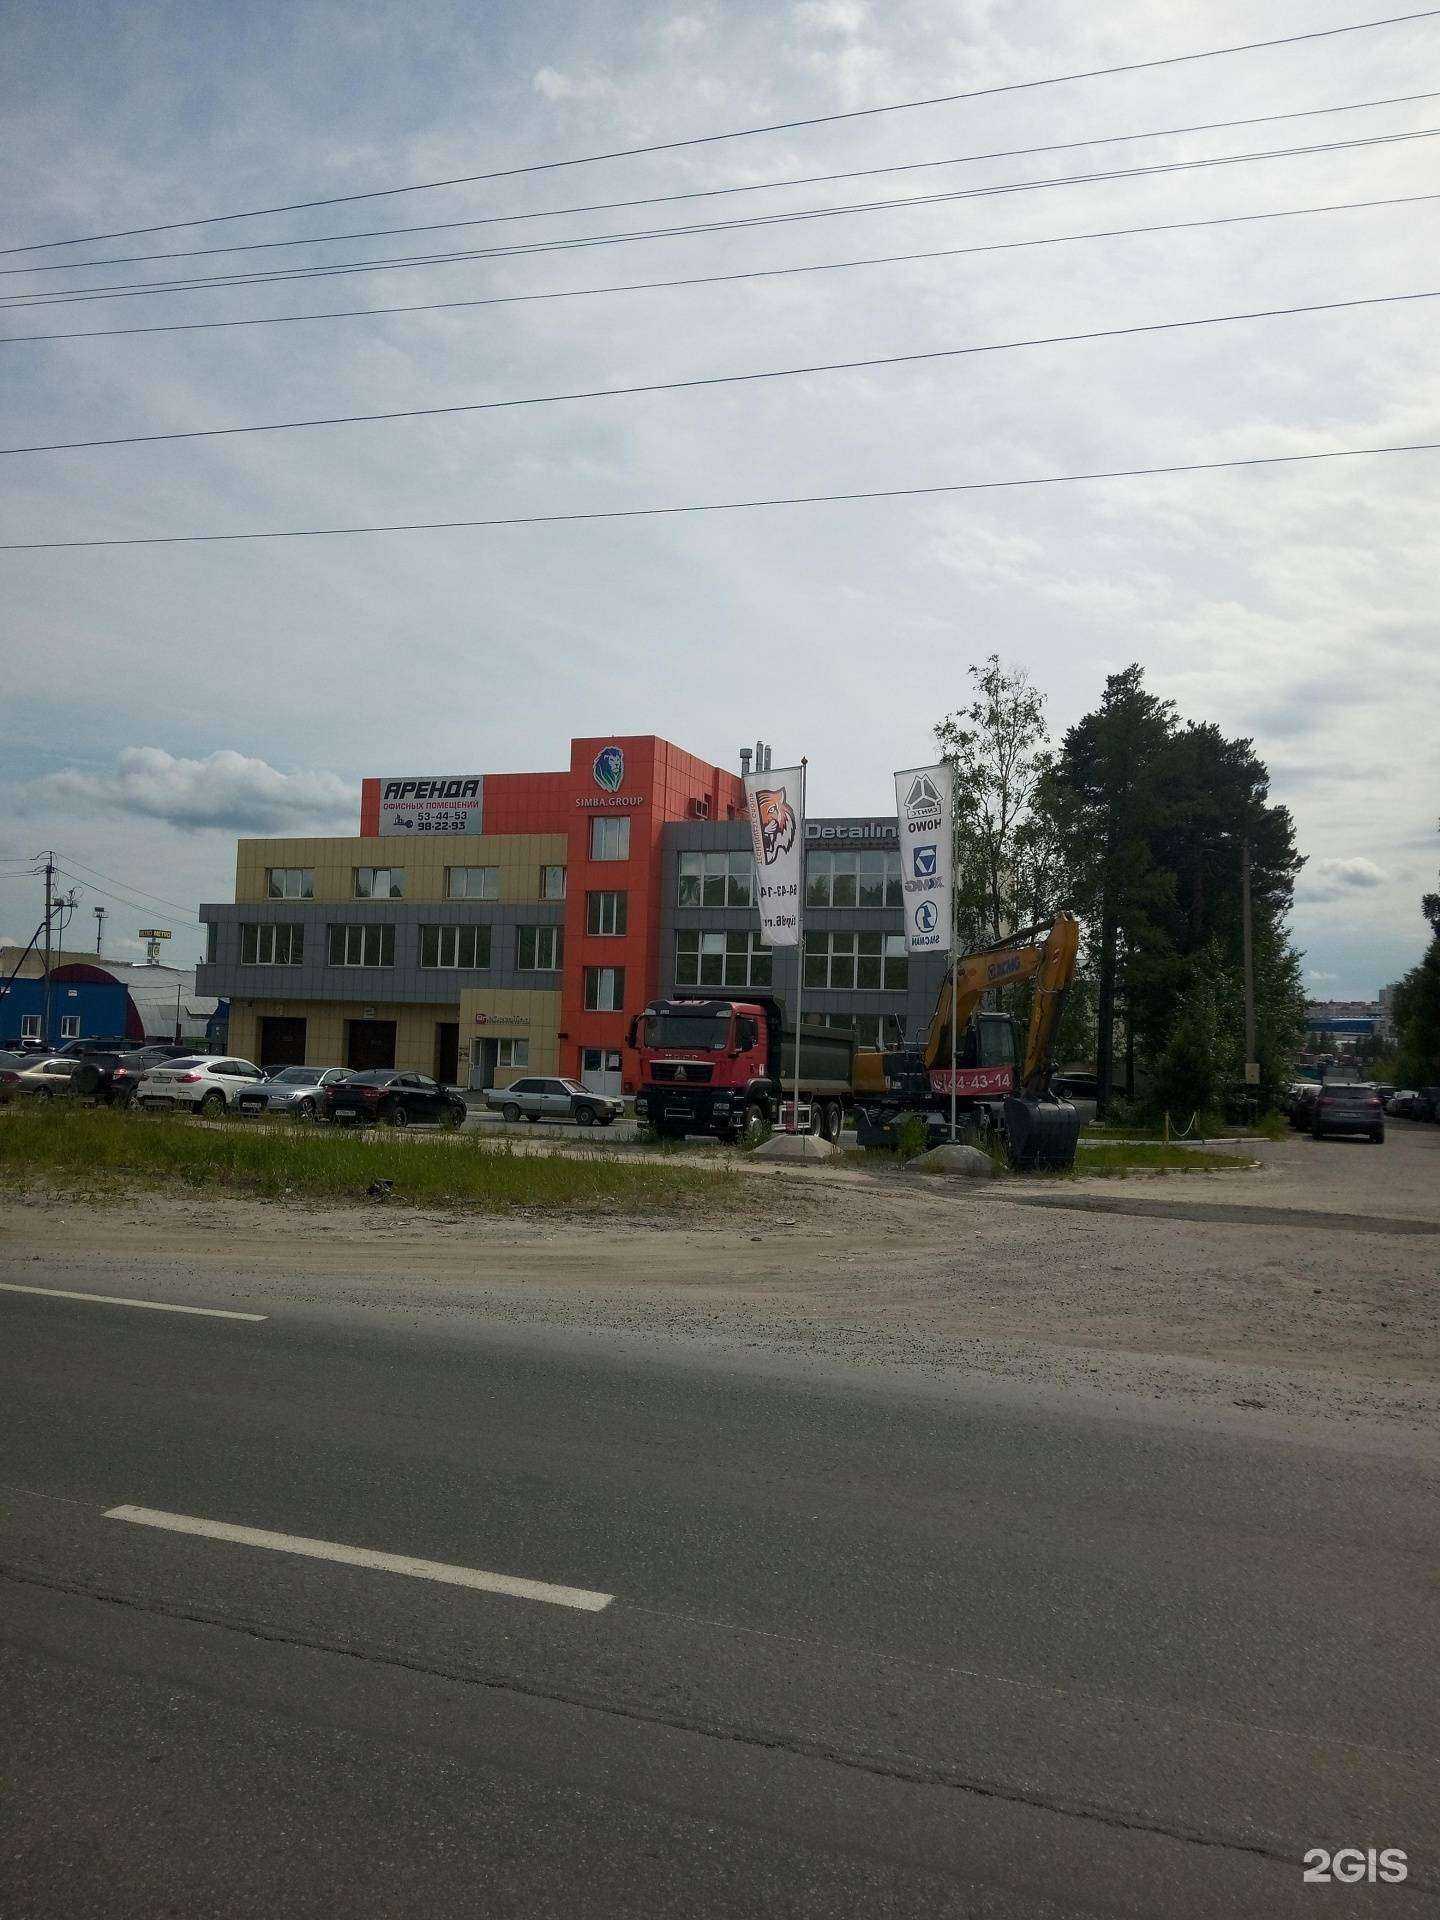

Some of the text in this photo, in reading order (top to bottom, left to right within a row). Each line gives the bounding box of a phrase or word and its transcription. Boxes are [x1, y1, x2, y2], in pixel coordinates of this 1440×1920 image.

[383, 779, 480, 800] АРЕНДА
[383, 800, 479, 810] ОФИСНЫХ ПОМЕЩЕНИЙ
[417, 811, 468, 821] 53-44-53
[804, 822, 901, 839] Detailin
